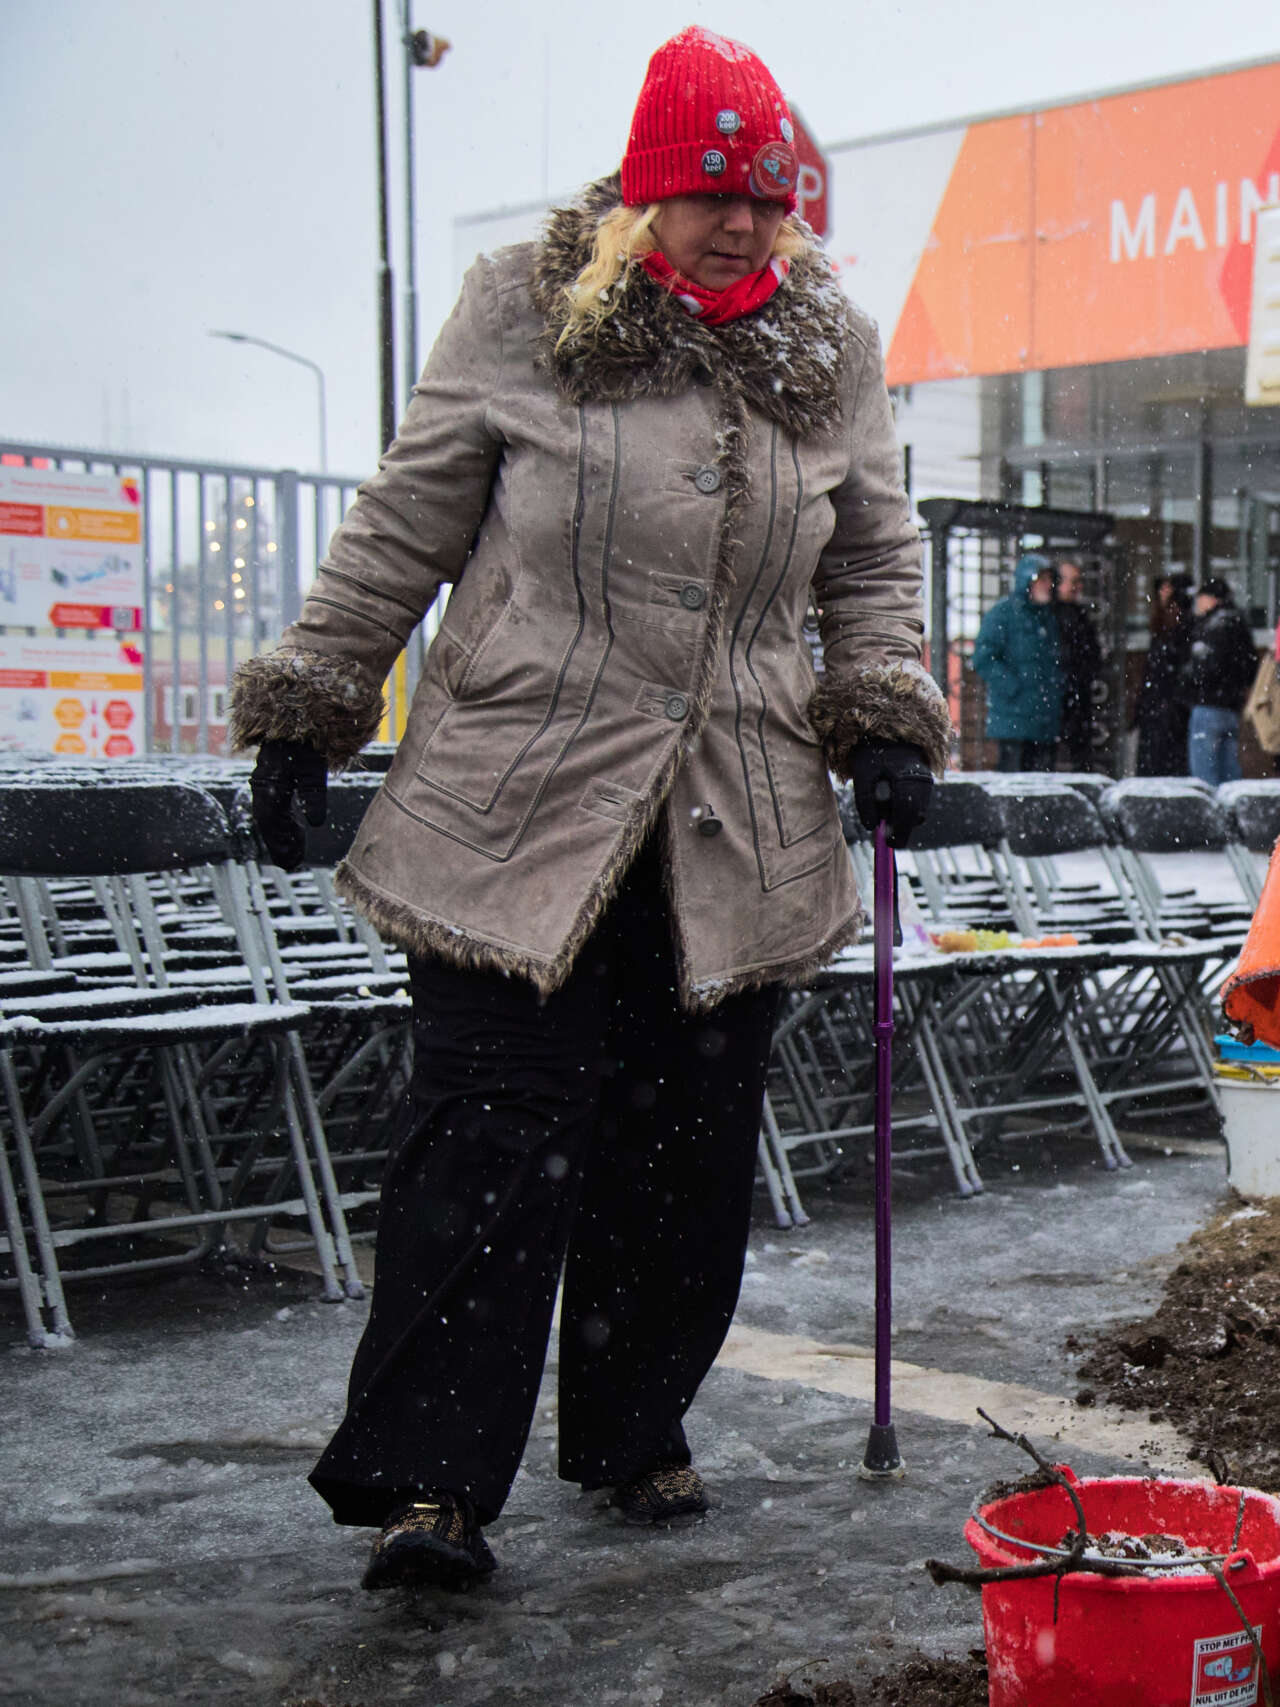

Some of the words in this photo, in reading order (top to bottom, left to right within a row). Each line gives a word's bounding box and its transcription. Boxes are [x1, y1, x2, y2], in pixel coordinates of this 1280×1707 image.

[706, 154, 721, 164] 150
[1110, 173, 1280, 263] MAIN
[1200, 1642, 1221, 1652] STOP
[1223, 1638, 1240, 1647] MET
[1196, 1695, 1213, 1705] NUL
[1214, 1691, 1228, 1702] UIT
[1229, 1688, 1239, 1697] DE
